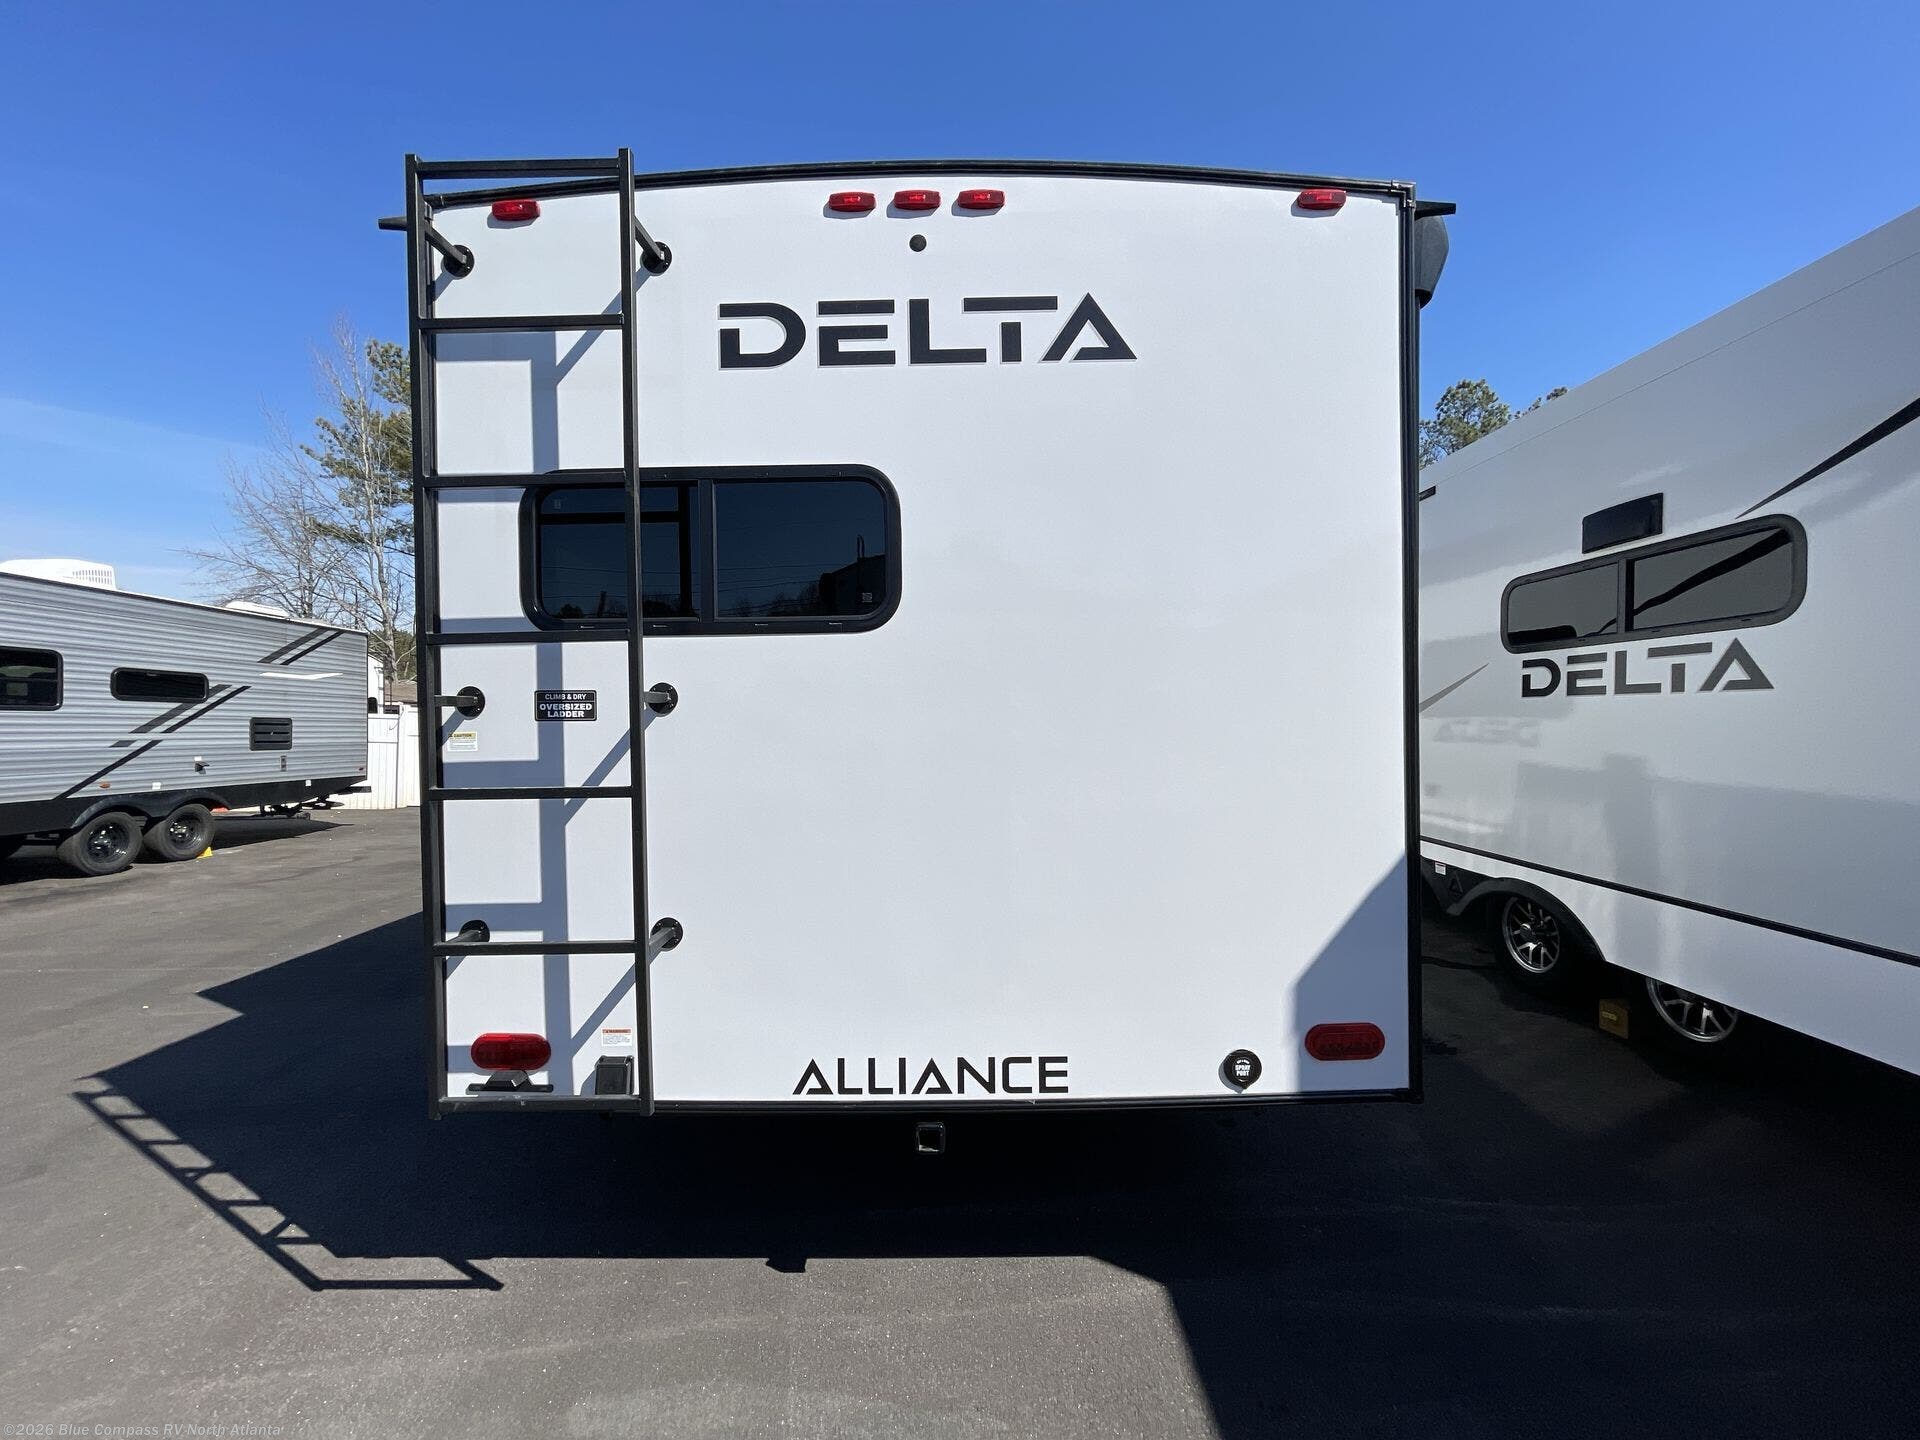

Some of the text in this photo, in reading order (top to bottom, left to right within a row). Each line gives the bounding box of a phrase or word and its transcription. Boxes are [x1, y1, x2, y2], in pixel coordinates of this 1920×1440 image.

[719, 292, 1137, 368] DELTA
[1521, 637, 1775, 698] DELTA
[539, 703, 593, 711] OVERSIZED
[547, 710, 585, 718] LADDER
[793, 1056, 1069, 1095] ALLIANCE
